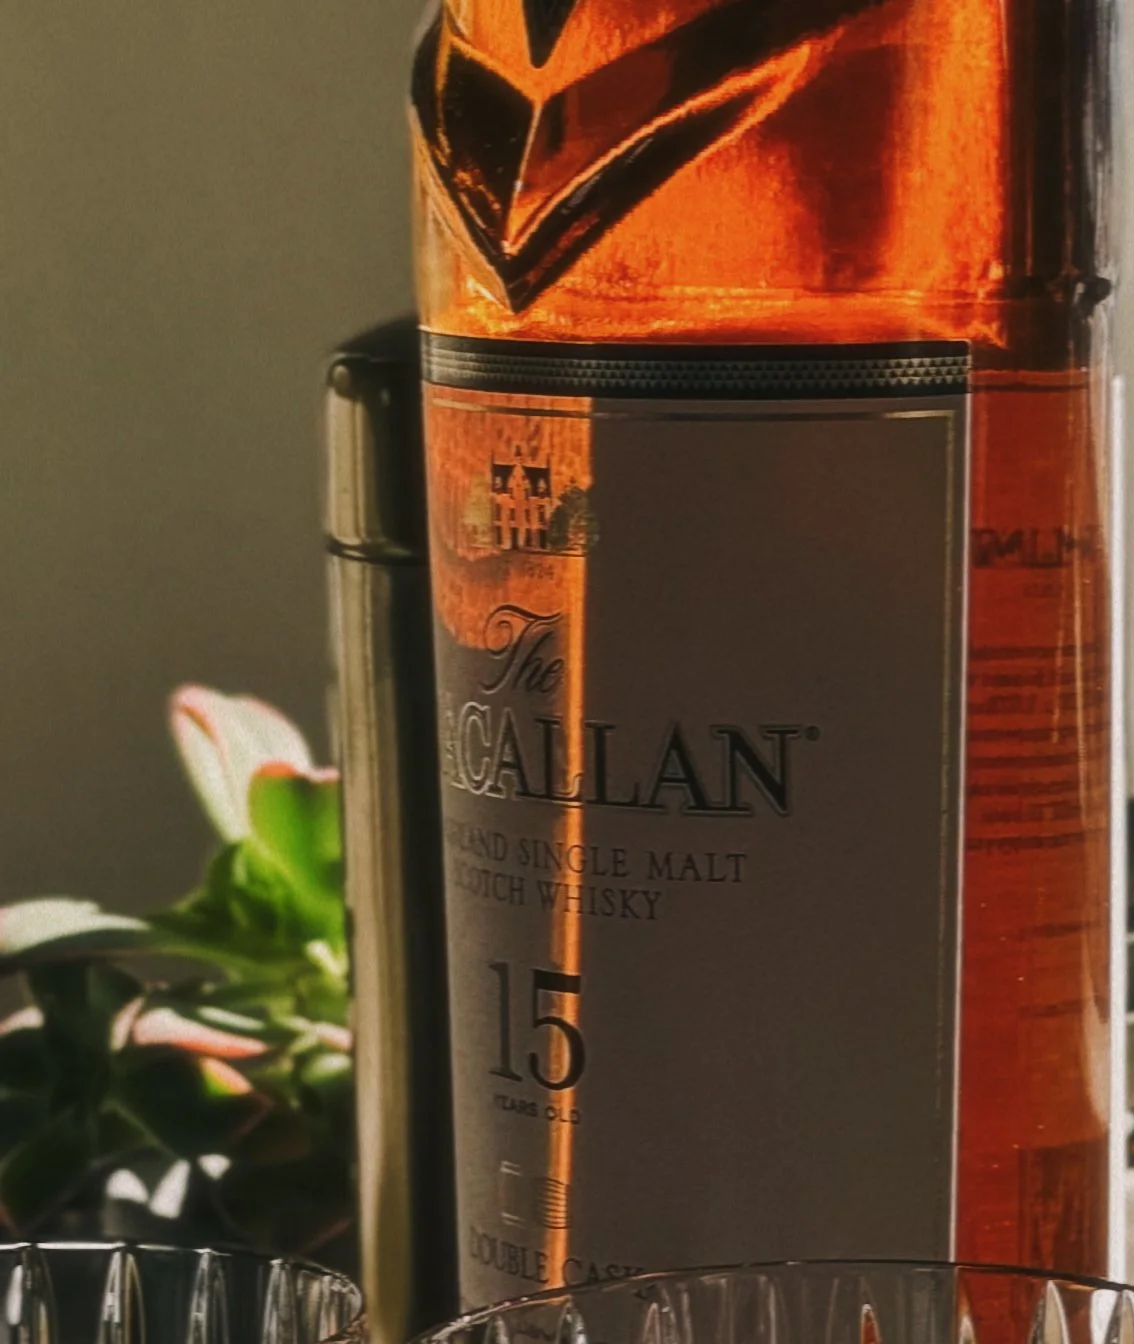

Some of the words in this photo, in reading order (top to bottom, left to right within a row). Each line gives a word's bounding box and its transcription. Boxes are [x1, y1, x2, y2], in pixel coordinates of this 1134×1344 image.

[480, 604, 566, 693] The
[450, 701, 801, 818] ACALLAN
[519, 837, 629, 878] SINGLE
[647, 851, 748, 884] MALT
[538, 880, 663, 921] WHISKY
[489, 961, 586, 1091] 15
[545, 1104, 581, 1125] OLD
